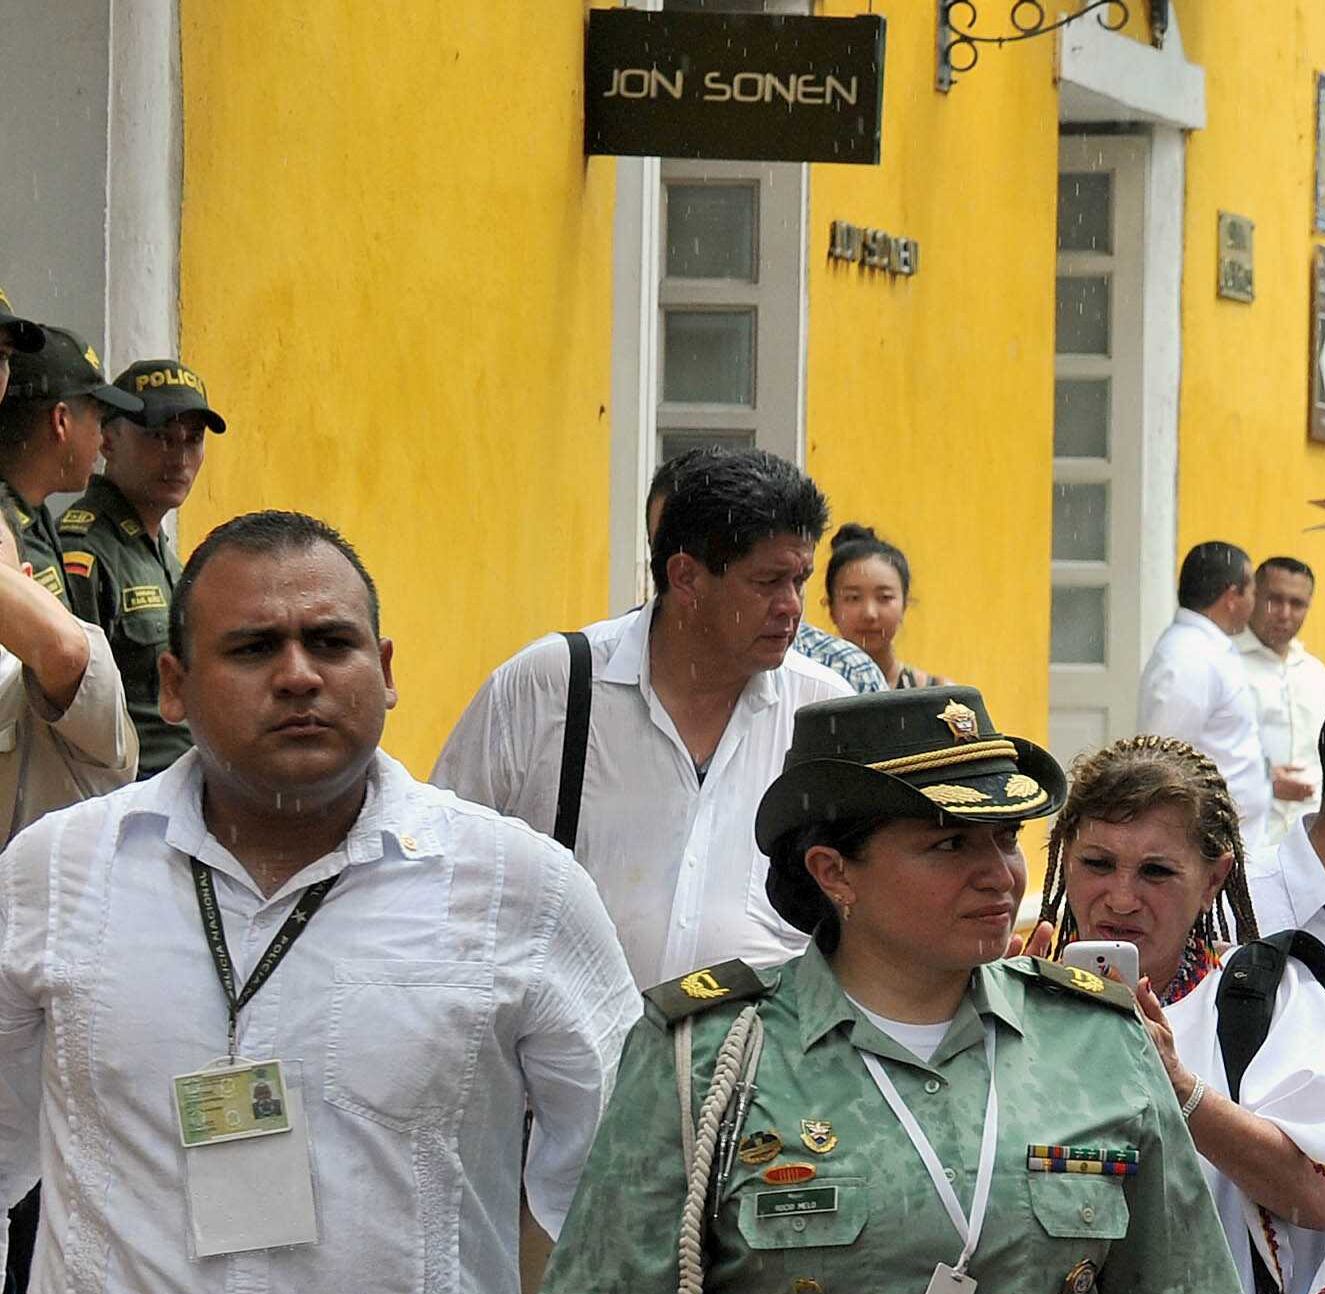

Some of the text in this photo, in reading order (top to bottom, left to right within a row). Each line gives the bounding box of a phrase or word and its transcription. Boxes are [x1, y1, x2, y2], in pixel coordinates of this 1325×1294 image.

[603, 68, 858, 104] JON SONEN
[199, 871, 220, 941] NACIONAL
[253, 935, 289, 984] POLICIA
